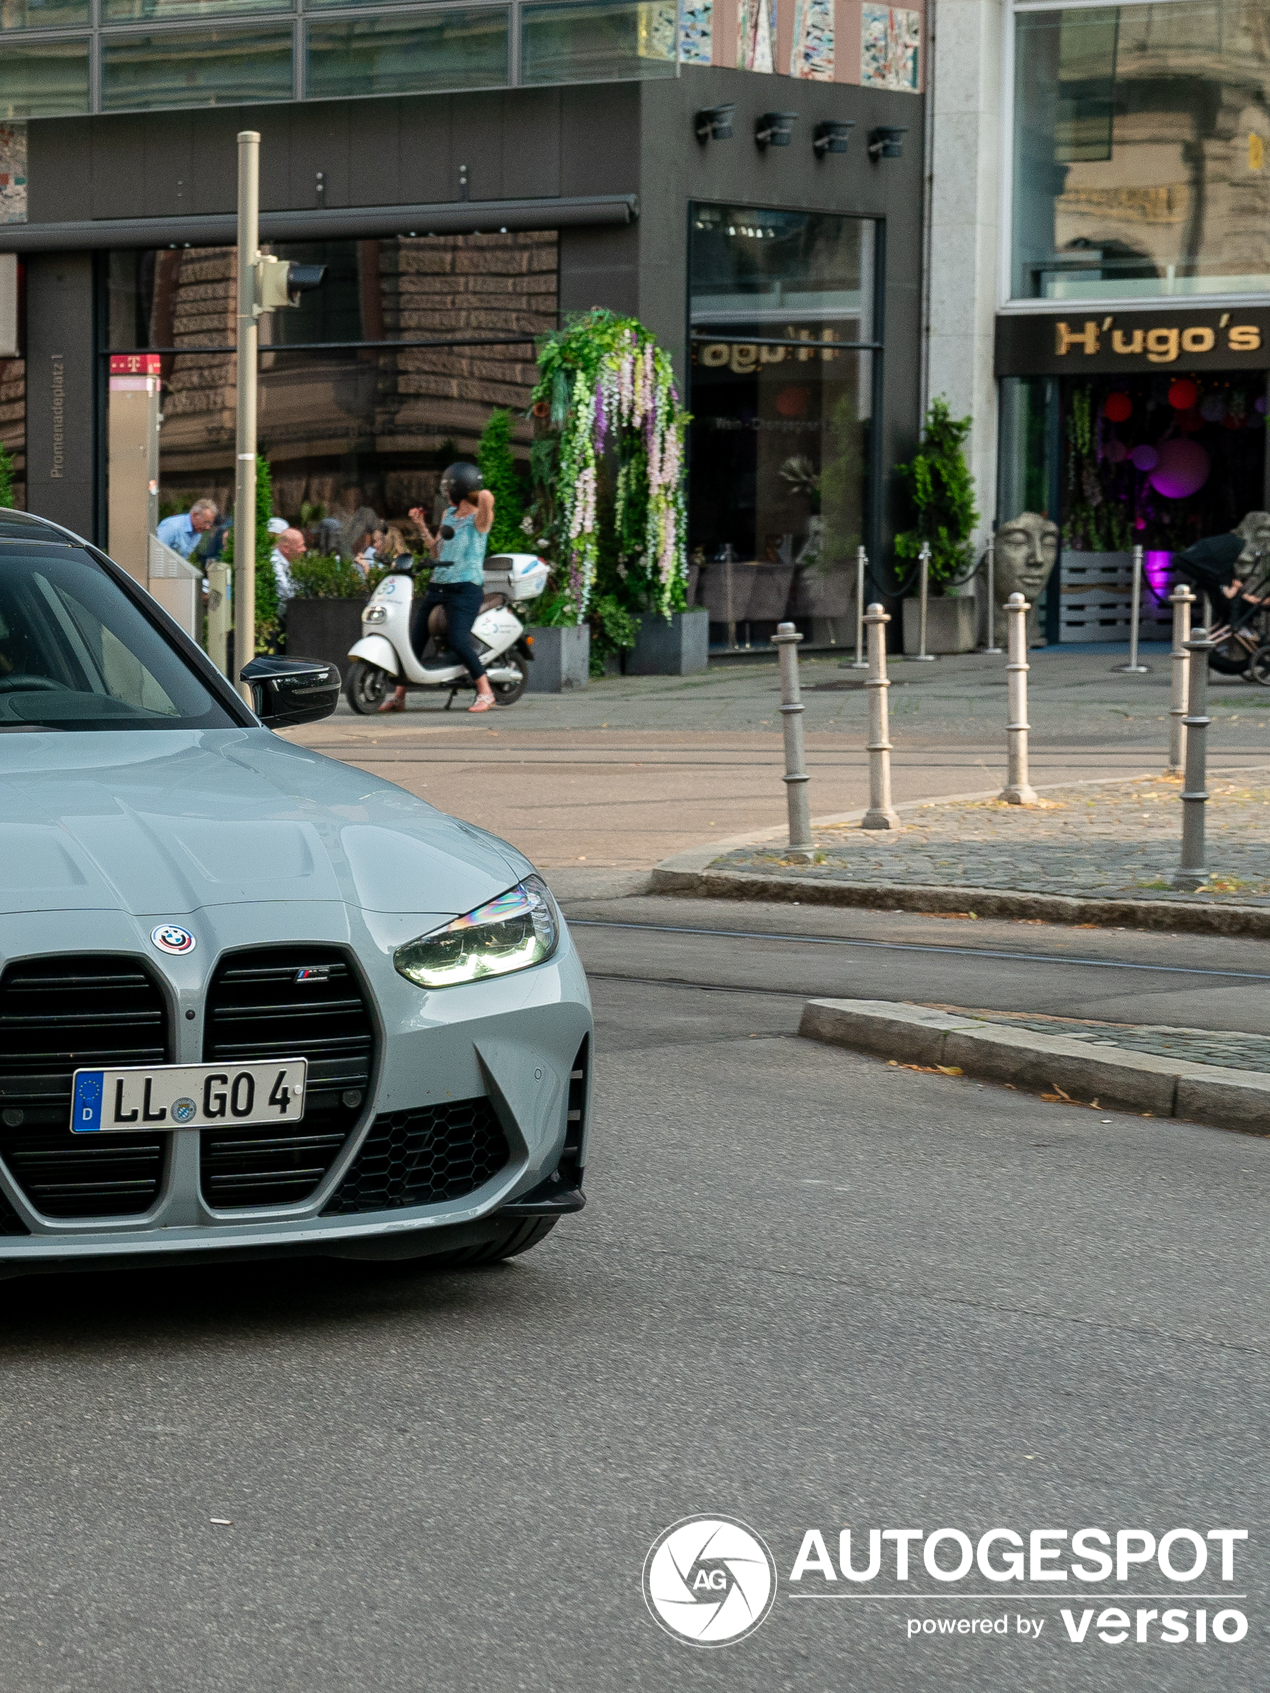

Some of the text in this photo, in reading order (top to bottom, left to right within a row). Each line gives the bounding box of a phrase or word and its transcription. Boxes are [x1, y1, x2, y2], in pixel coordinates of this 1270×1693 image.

[1054, 312, 1262, 364] H'ugo's
[81, 1107, 94, 1121] D
[114, 1068, 291, 1123] LL GO 4
